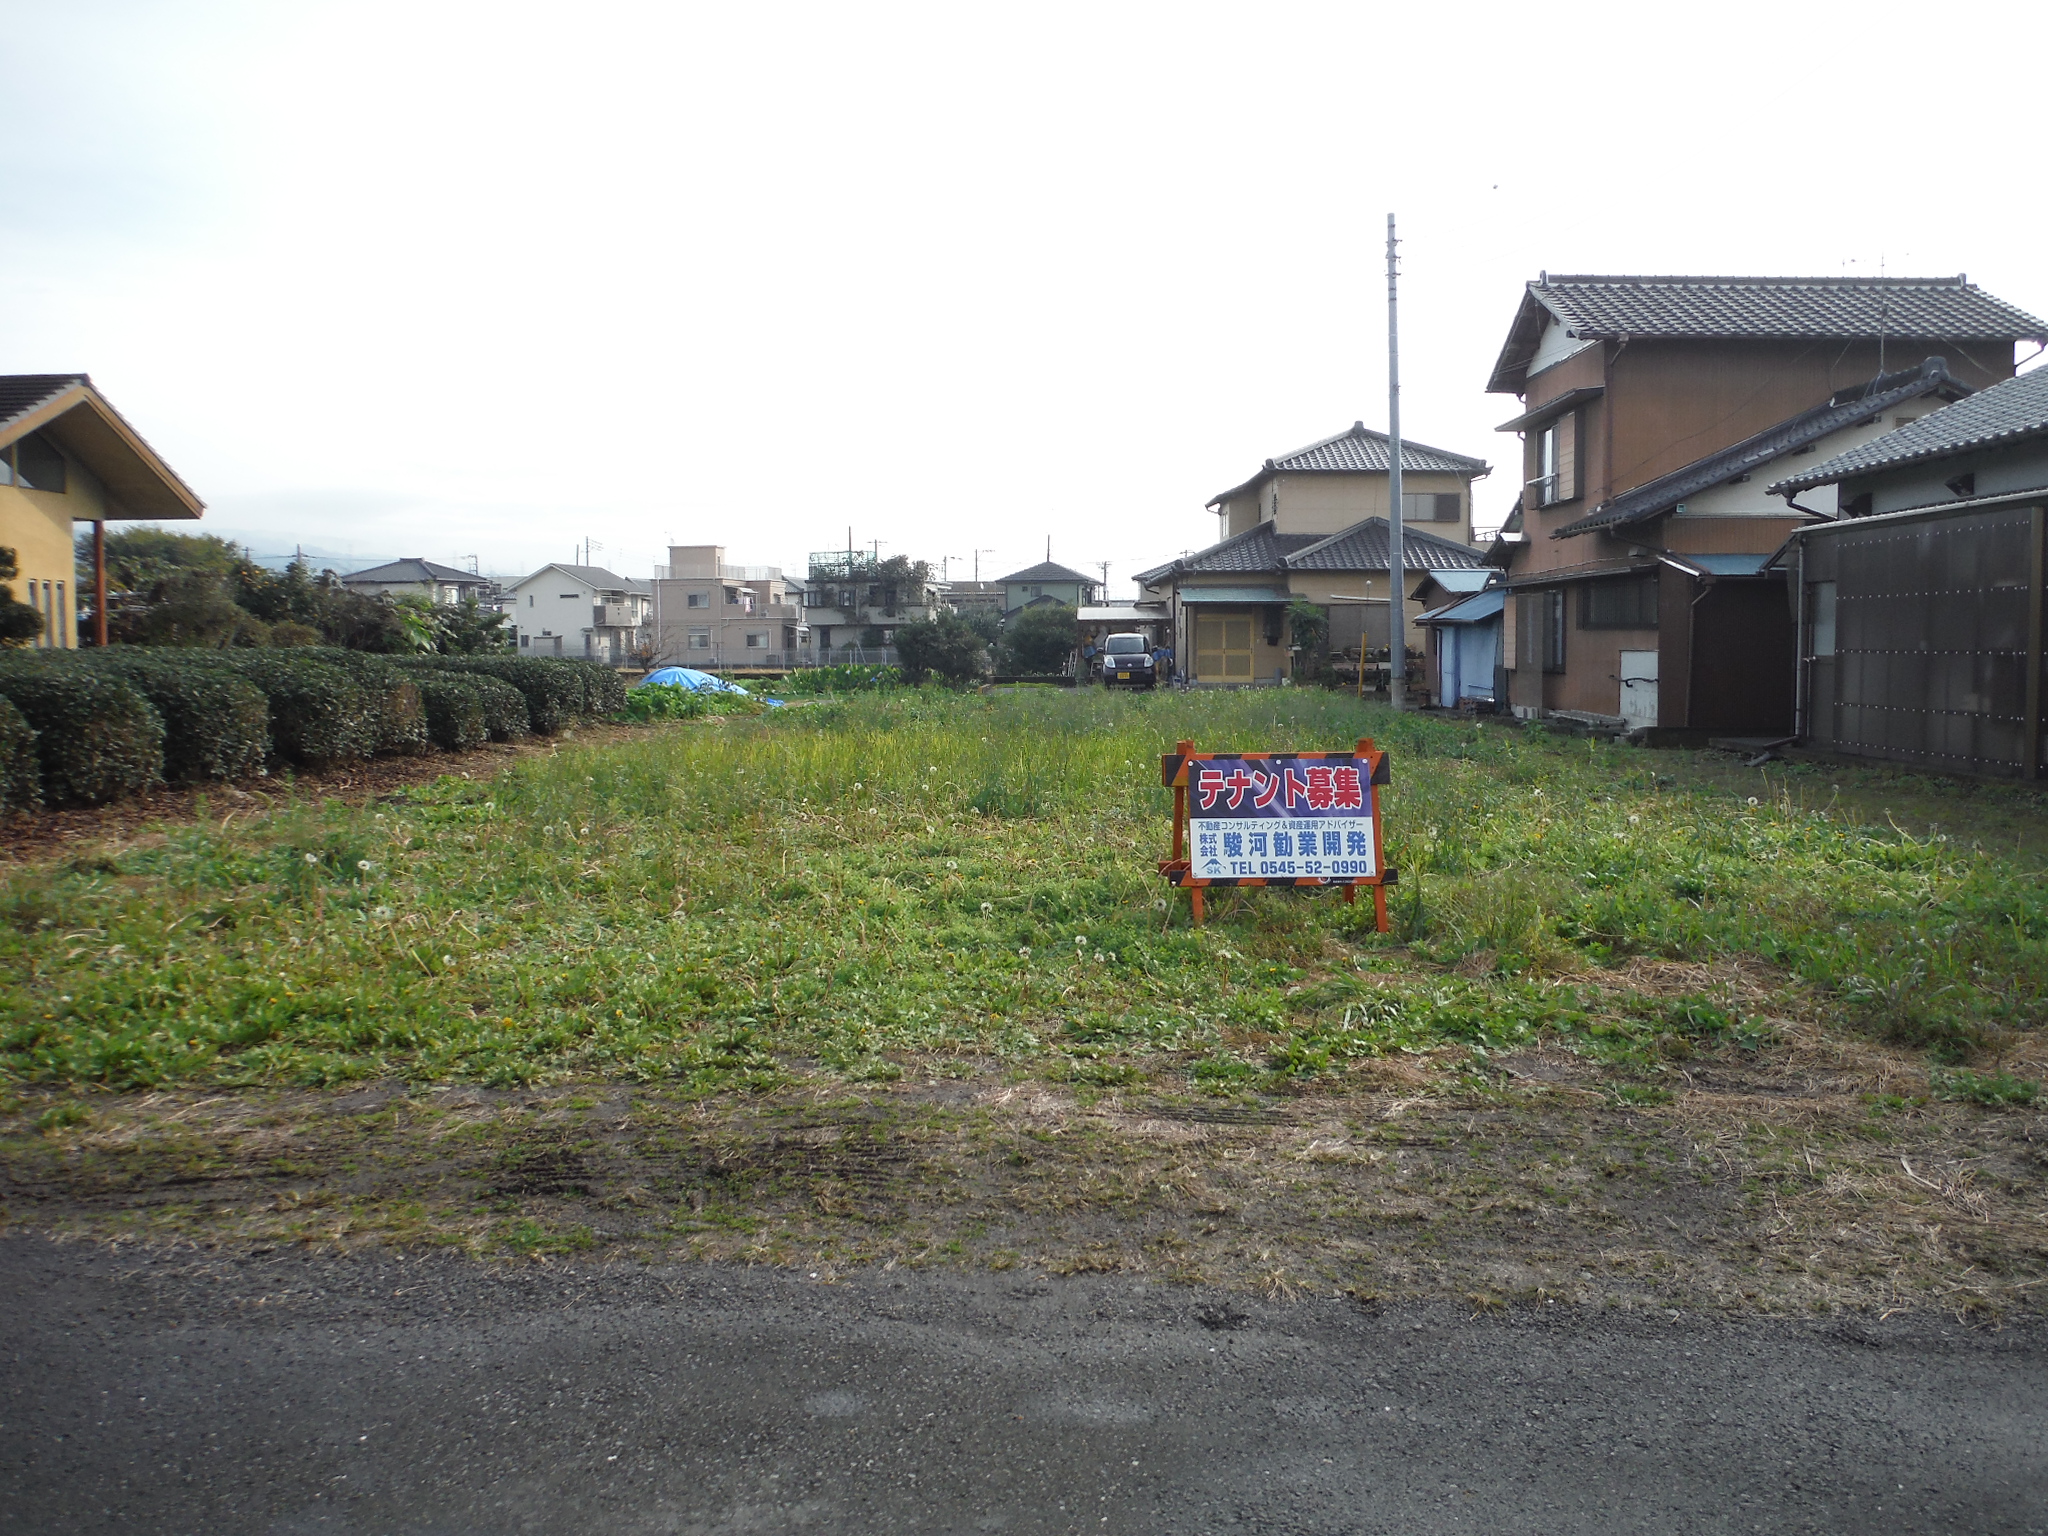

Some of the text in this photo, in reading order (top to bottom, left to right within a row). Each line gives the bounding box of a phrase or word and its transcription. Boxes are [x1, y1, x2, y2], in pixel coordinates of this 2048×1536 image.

[1198, 766, 1362, 810] テナント募集
[1199, 833, 1217, 845] 株式
[1223, 831, 1367, 857] 駿河勧業開発
[1200, 845, 1218, 857] 会社
[1206, 866, 1222, 875] SK
[1230, 860, 1367, 875] TEL 0545-52-0990
